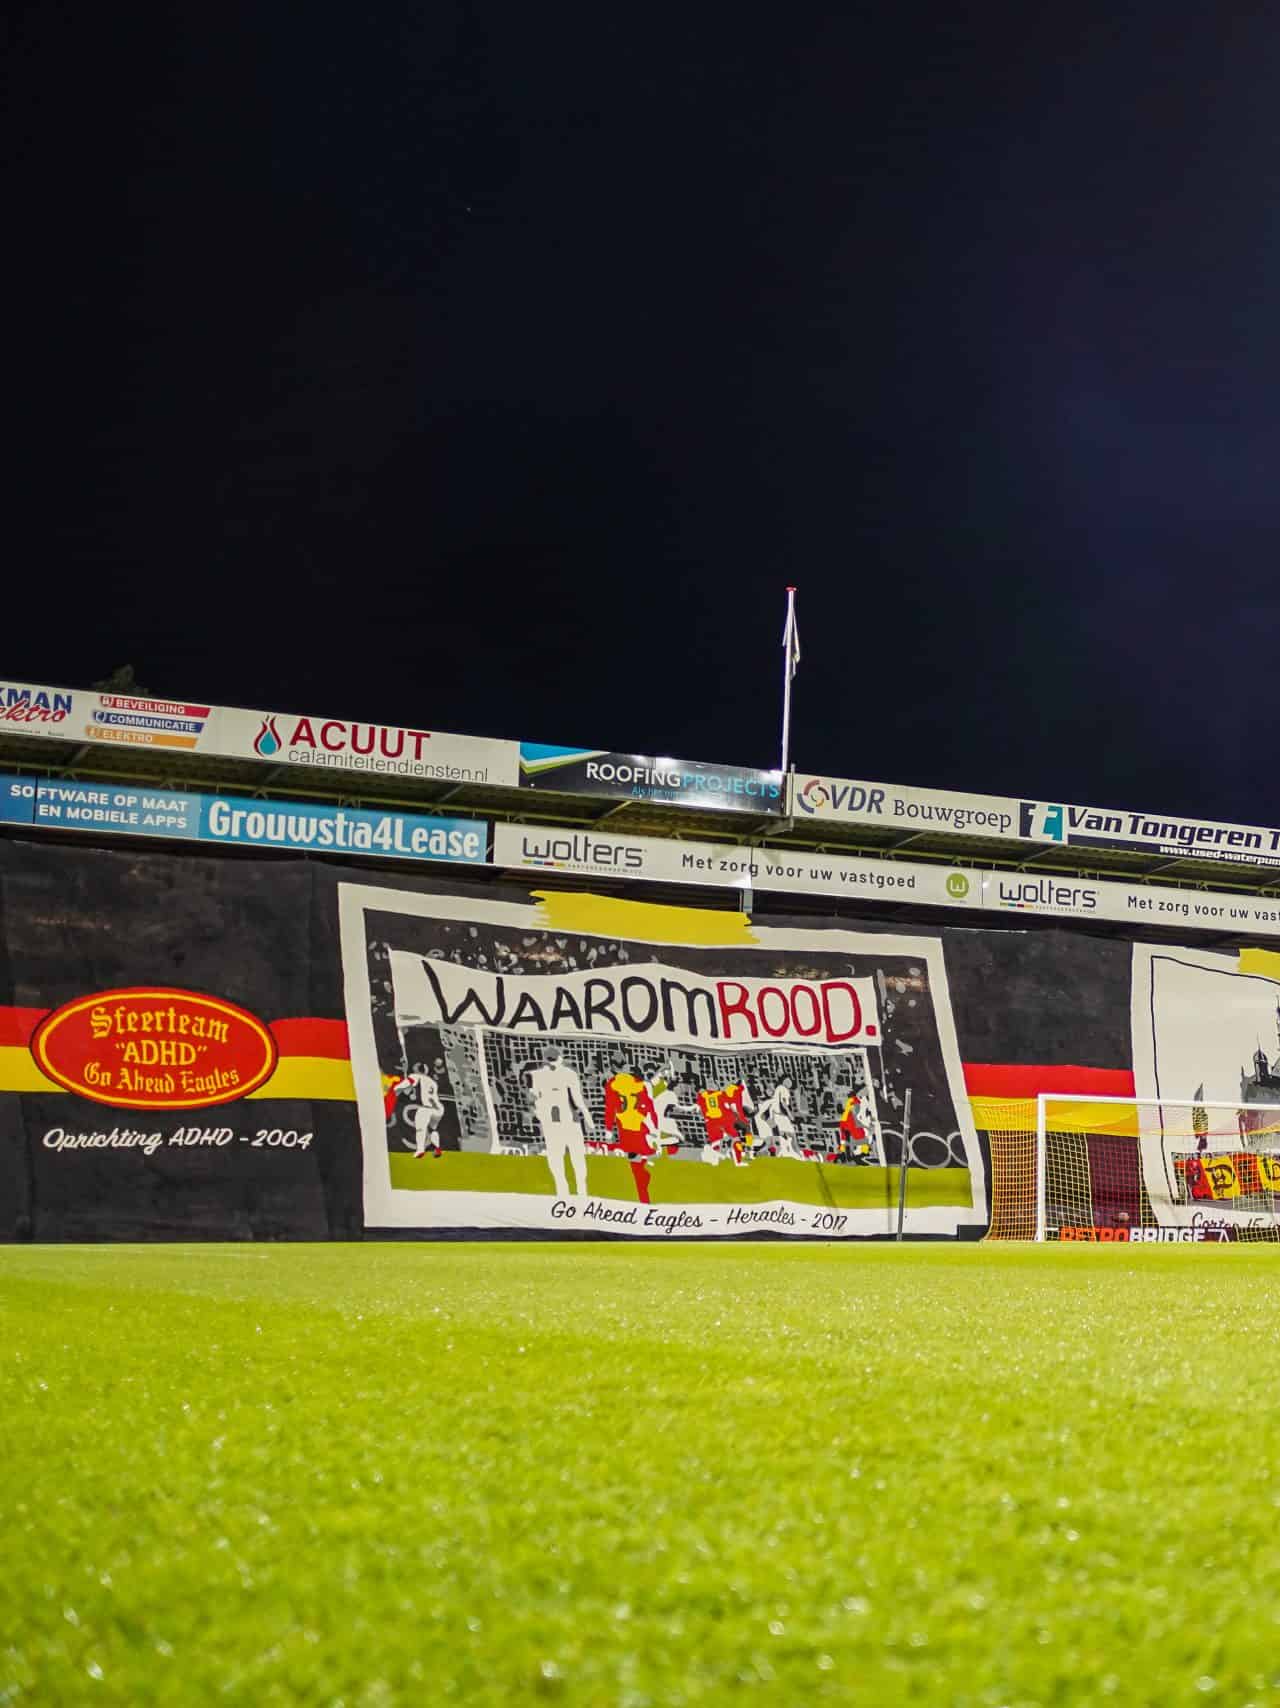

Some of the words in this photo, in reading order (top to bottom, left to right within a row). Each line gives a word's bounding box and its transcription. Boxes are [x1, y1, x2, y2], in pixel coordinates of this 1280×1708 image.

[116, 699, 185, 714] BEVEILIGING
[103, 731, 153, 742] ELEKTRO
[109, 714, 196, 731] COMMUNICATIE
[289, 718, 431, 761] ACUUT
[288, 750, 488, 782] calamiteitendiensten.nl
[587, 762, 780, 798] ROOFINGPROJECTS
[10, 784, 109, 805] SOFTWARE
[114, 795, 137, 807] OP
[142, 798, 188, 812] MAAT
[831, 784, 885, 814] VDR
[39, 805, 61, 817] EN
[67, 807, 138, 825] MOBIELE
[144, 815, 187, 829] APPS
[894, 800, 1012, 833] Bouwgroep
[1068, 807, 1122, 833] Van
[1128, 814, 1262, 849] Tongeren
[522, 835, 643, 868] wolters
[682, 854, 713, 870] Met
[720, 860, 758, 877] zorg
[766, 864, 804, 878] voor
[810, 868, 833, 880] uw
[840, 869, 916, 889] vastgoed
[999, 880, 1097, 908] wolters
[1127, 896, 1153, 910] Met
[1158, 901, 1189, 916] zorg
[1194, 905, 1225, 917] voor
[1230, 907, 1249, 919] uw
[84, 1063, 111, 1088] Go
[118, 1070, 175, 1094] Ahead
[180, 1068, 240, 1096] Eagles
[43, 1128, 163, 1155] Oprichting
[168, 1128, 234, 1147] ADHD
[251, 1129, 313, 1149] 2004
[551, 1200, 577, 1219] Go
[584, 1202, 637, 1225] Ahead
[644, 1208, 704, 1233] Eagles
[727, 1206, 796, 1225] Heracles
[811, 1213, 848, 1231] 2017
